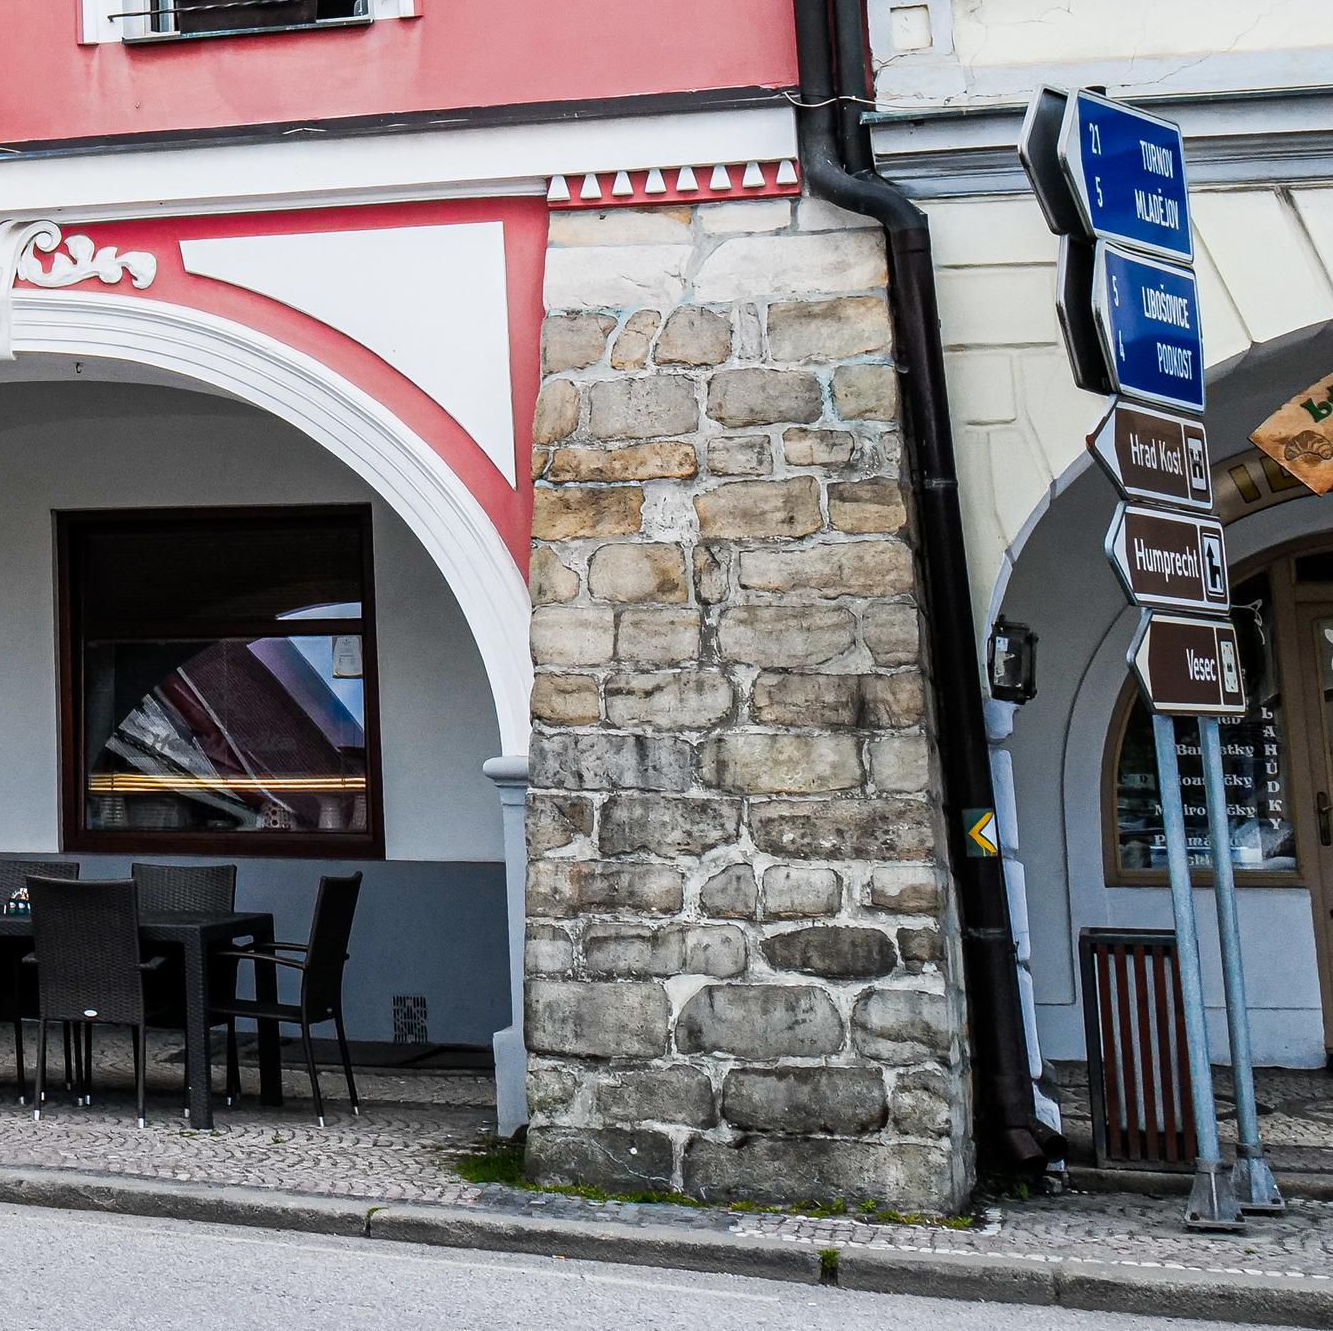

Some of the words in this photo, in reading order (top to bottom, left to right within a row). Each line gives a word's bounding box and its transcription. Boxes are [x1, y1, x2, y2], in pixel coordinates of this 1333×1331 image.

[1089, 122, 1101, 155] 21
[1139, 139, 1173, 179] TURNOV
[1095, 176, 1103, 208] 5
[1134, 188, 1179, 230] MLADĚJOV
[1112, 275, 1120, 307] 5
[1141, 284, 1190, 329] LIBOŠOVICE
[1118, 330, 1126, 362] 4
[1156, 342, 1193, 381] PODKOST
[1129, 432, 1158, 471] Hrad
[1158, 441, 1183, 476] Kost
[1134, 537, 1200, 582] Humprecht
[1186, 648, 1217, 682] Vesec
